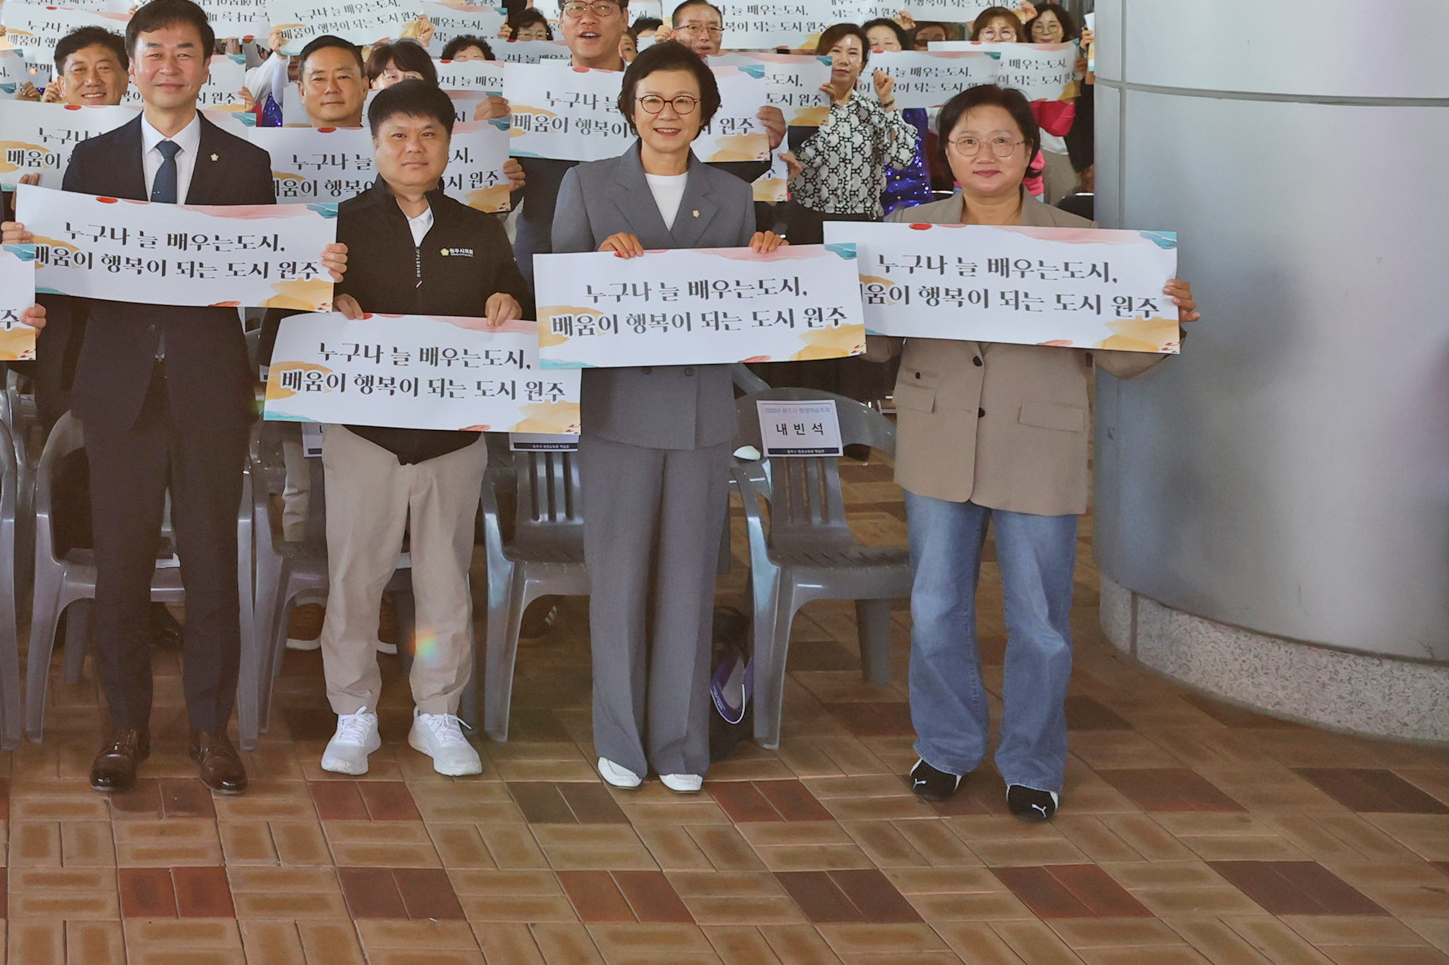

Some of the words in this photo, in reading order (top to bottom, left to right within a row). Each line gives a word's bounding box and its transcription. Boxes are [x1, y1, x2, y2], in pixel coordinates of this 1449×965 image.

[212, 92, 235, 104] 원주
[546, 91, 598, 110] 누구나
[515, 113, 568, 133] 배움이
[575, 118, 627, 138] 행복이
[720, 118, 754, 134] 원주
[8, 150, 60, 169] 배움이
[293, 154, 348, 170] 누구나
[356, 154, 372, 170] 늘
[469, 170, 498, 188] 원주
[66, 222, 130, 245] 누구나
[138, 231, 158, 249] 늘
[37, 246, 92, 269] 배움이
[101, 254, 166, 277] 행복이
[177, 261, 217, 278] 되는
[227, 262, 268, 279] 도시
[278, 262, 318, 279] 원주
[879, 255, 948, 275] 누구나
[956, 257, 978, 277] 늘
[587, 282, 652, 303] 누구나
[659, 282, 679, 301] 늘
[860, 283, 909, 305] 움이
[919, 286, 988, 309] 행복이
[1000, 290, 1044, 312] 되는
[1055, 293, 1101, 315] 도시
[1111, 296, 1159, 318] 원주
[552, 314, 618, 336] 배움이
[626, 312, 691, 334] 행복이
[701, 311, 742, 331] 되는
[752, 309, 794, 328] 도시
[804, 307, 846, 327] 원주
[319, 343, 384, 364] 누구나
[391, 347, 411, 366] 늘
[283, 371, 345, 392] 배움이
[354, 374, 418, 397] 행복이
[429, 378, 464, 398] 되는
[476, 380, 515, 400] 도시
[524, 381, 565, 401] 원주
